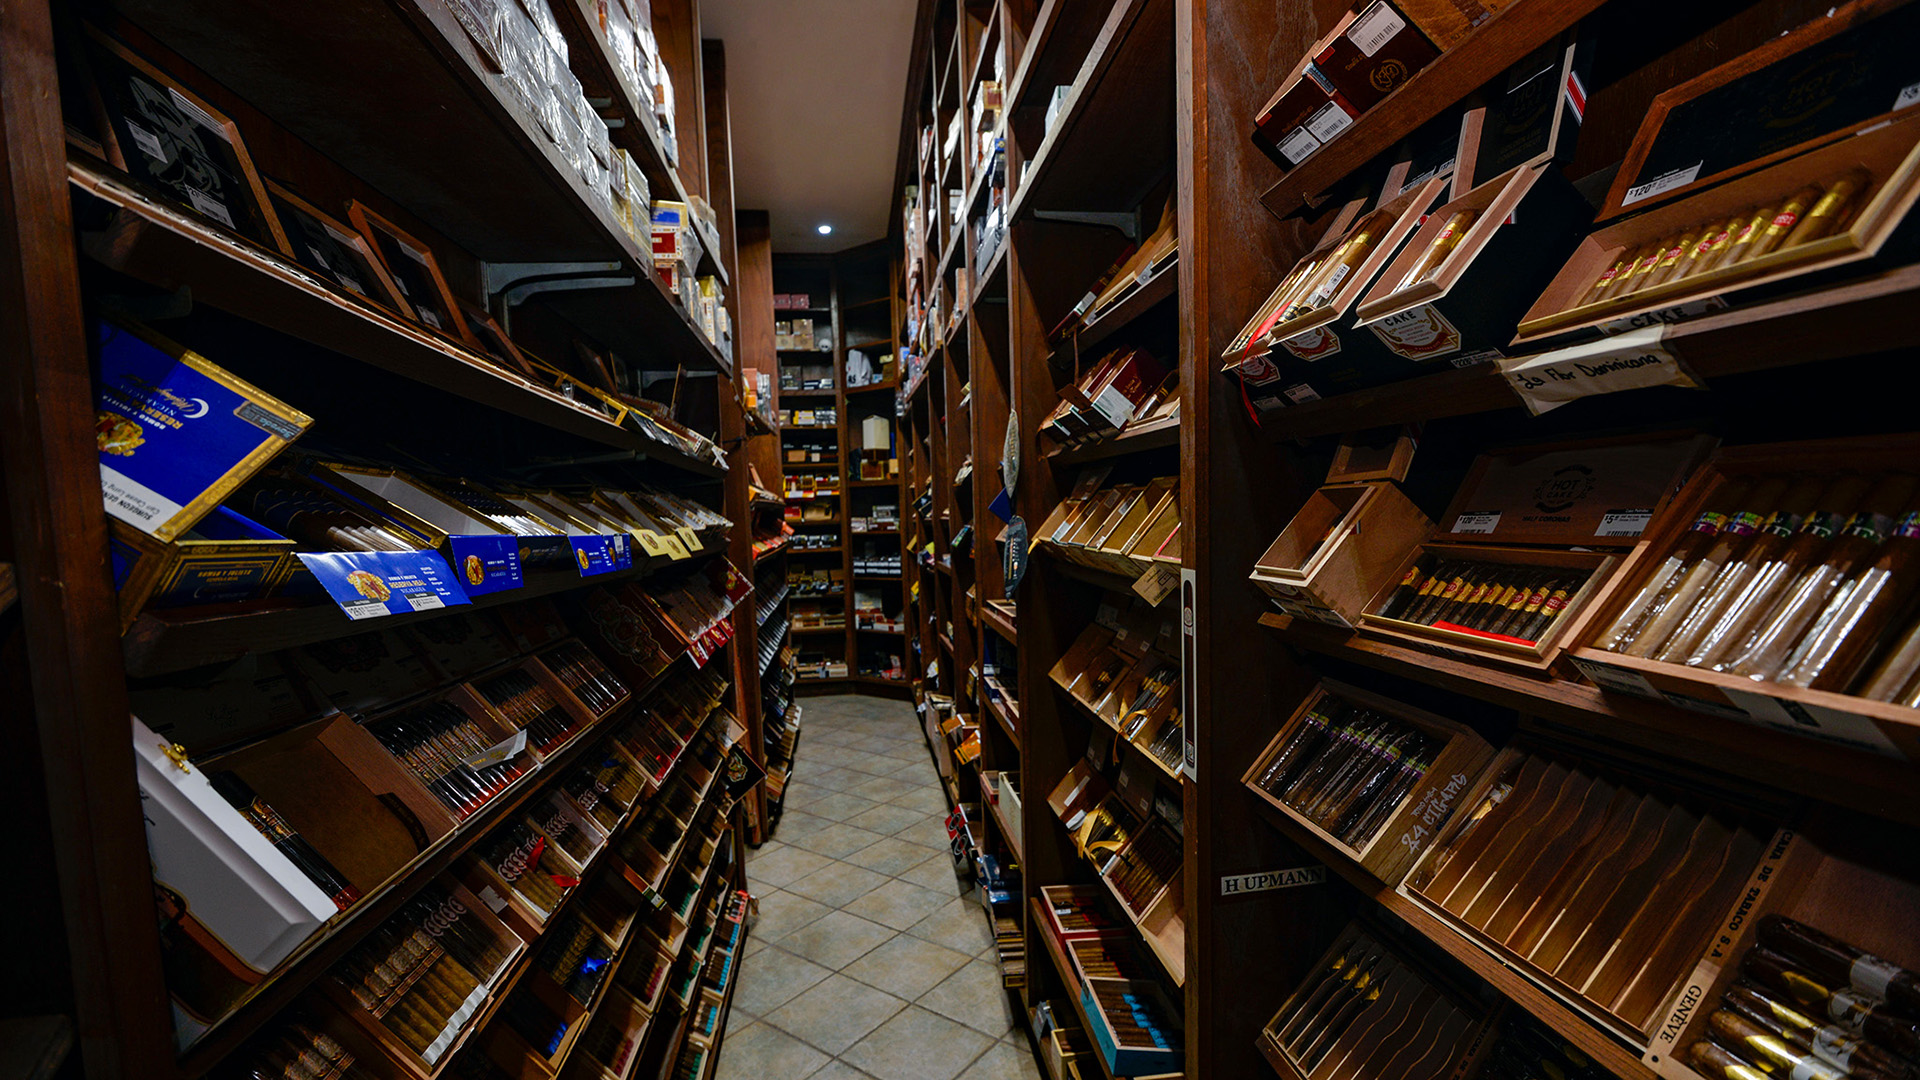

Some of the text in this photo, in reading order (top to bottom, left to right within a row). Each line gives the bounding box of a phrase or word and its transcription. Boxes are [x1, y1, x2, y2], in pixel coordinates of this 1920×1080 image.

[1384, 310, 1417, 327] CAKE
[1630, 308, 1688, 327] CAKE
[1552, 479, 1579, 490] HOT
[1225, 869, 1322, 893] H UPMANN
[1757, 866, 1773, 882] DE
[1729, 887, 1760, 931] TABACO
[1660, 985, 1702, 1044] GENÈVE
